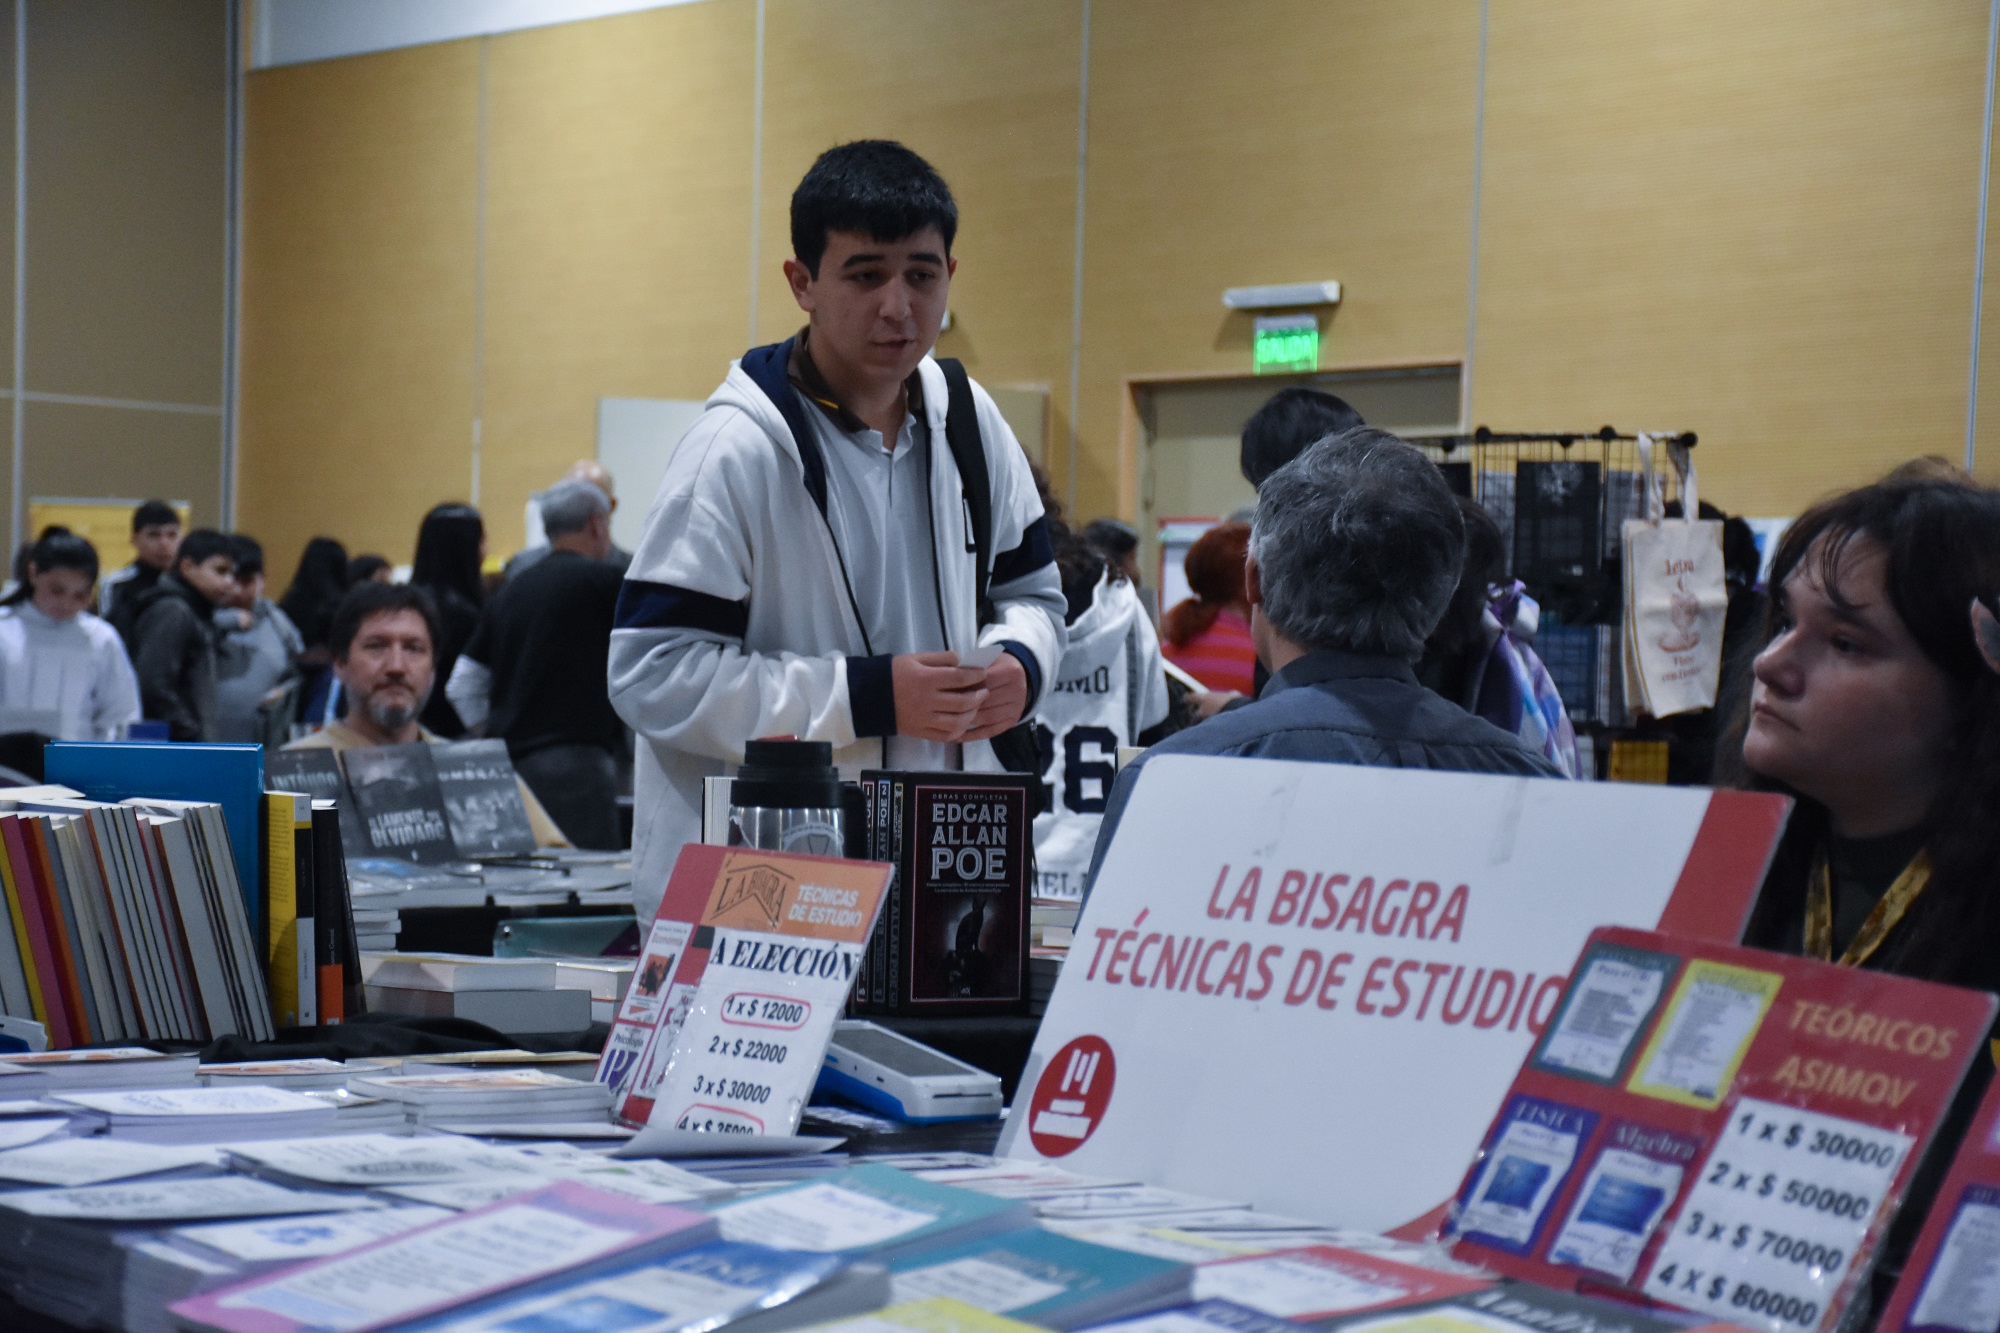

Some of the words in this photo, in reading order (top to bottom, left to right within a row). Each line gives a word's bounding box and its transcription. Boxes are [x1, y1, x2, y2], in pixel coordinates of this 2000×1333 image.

[881, 785, 887, 796] 2
[880, 798, 888, 828] POE
[932, 802, 1008, 823] EDGAR
[931, 825, 1007, 846] ALLAN
[931, 846, 1007, 880] POE
[716, 876, 746, 913] LA
[798, 883, 859, 908] TÉCNICAS
[1206, 863, 1263, 922] LA
[1267, 868, 1471, 943] BISAGRA
[788, 903, 807, 922] DE
[808, 907, 863, 928] ESTUDIO
[710, 937, 726, 965] A
[729, 939, 860, 982] ELECCIÓN
[1086, 906, 1285, 1002] TÉCNICAS
[1283, 948, 1355, 1011] DE
[1355, 956, 1570, 1037] ESTUDIO
[727, 996, 735, 1014] 1
[736, 1002, 745, 1016] x
[747, 999, 759, 1018] $
[762, 1001, 803, 1024] 12000
[1789, 1001, 1959, 1061] TEÓRICOS
[709, 1035, 720, 1053] 2
[719, 1041, 730, 1055] x
[732, 1038, 744, 1058] $
[743, 1040, 788, 1064] 22000
[693, 1075, 704, 1093] 3
[704, 1081, 715, 1095] x
[716, 1078, 727, 1098] $
[727, 1080, 771, 1104] 30000
[1772, 1055, 1918, 1109] ASIMOV
[678, 1115, 689, 1129] 4
[1739, 1113, 1755, 1135] 1
[1758, 1123, 1778, 1141] x
[1783, 1122, 1804, 1149] $
[1809, 1129, 1895, 1168] 30000
[1707, 1161, 1730, 1185] 2
[1733, 1172, 1752, 1190] x
[1758, 1172, 1778, 1199] $
[1782, 1178, 1870, 1221] 50000
[1686, 1211, 1704, 1236] 3
[1706, 1221, 1727, 1241] x
[1731, 1223, 1751, 1249] $
[1758, 1229, 1844, 1273] 70000
[1658, 1262, 1678, 1286] 4
[1708, 1275, 1727, 1302] $
[1732, 1283, 1819, 1327] 80000
